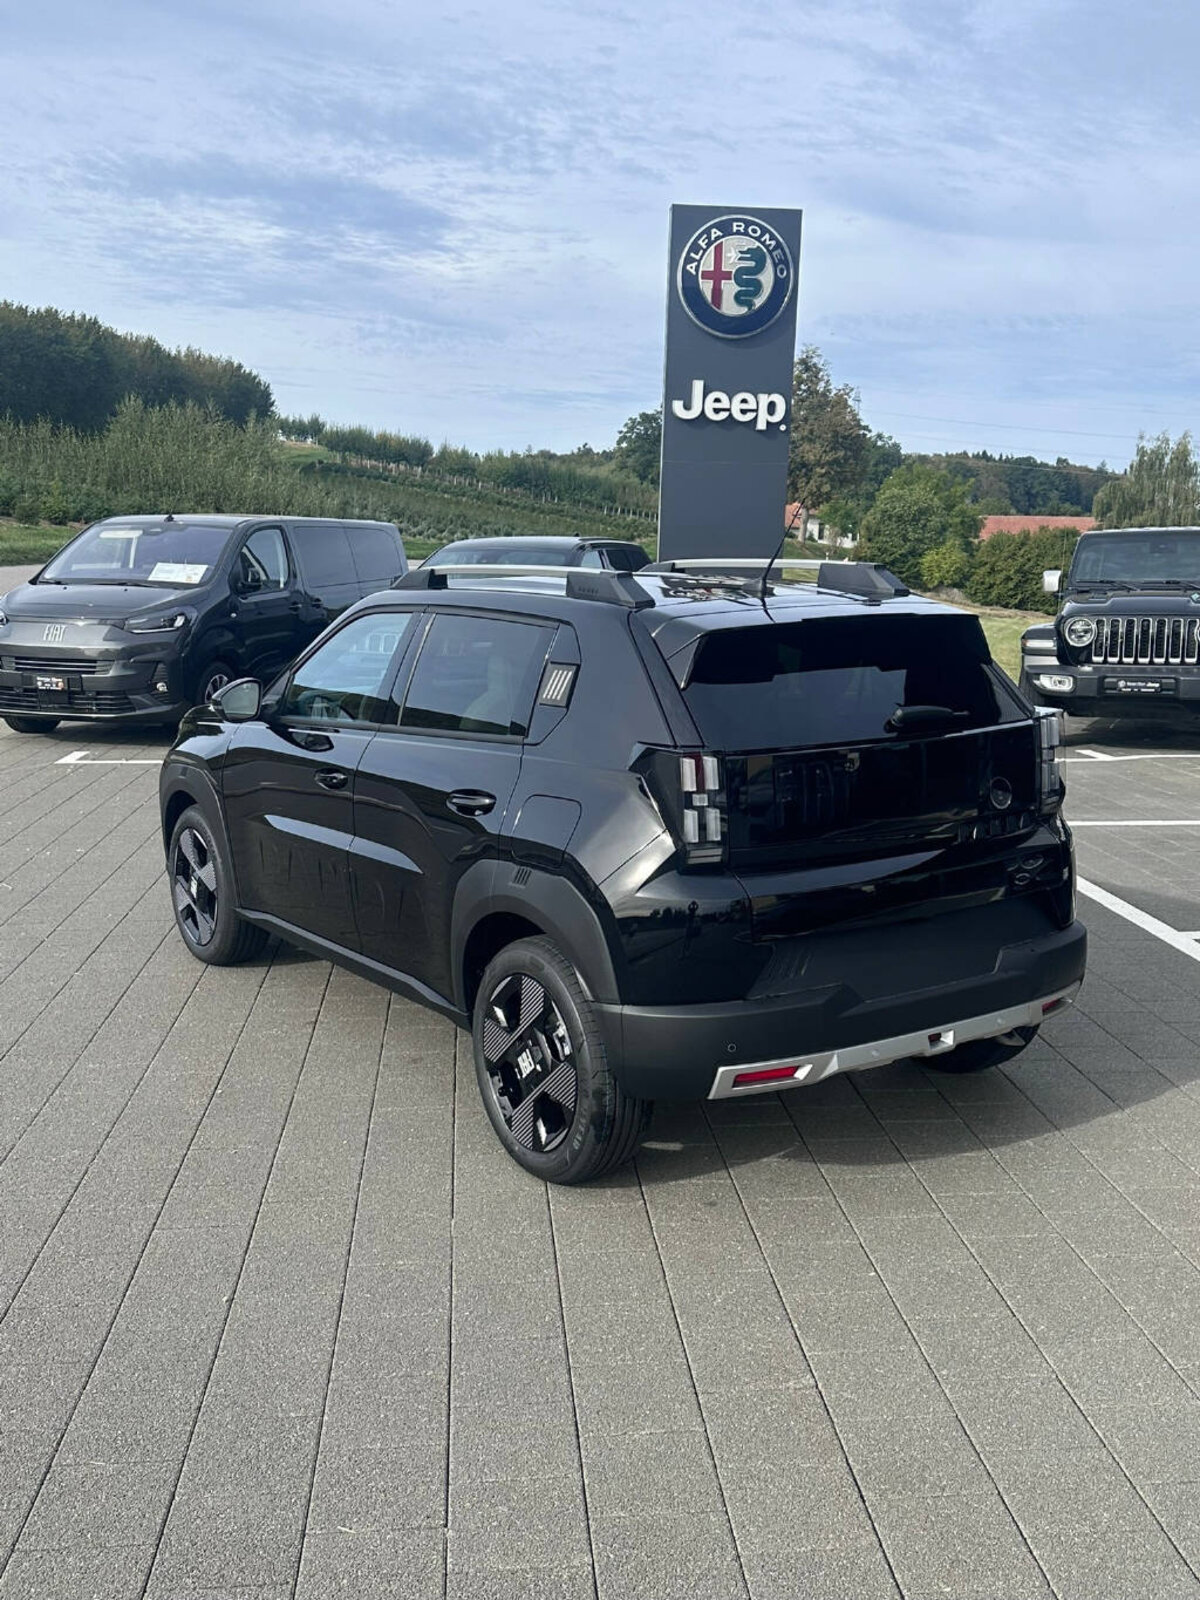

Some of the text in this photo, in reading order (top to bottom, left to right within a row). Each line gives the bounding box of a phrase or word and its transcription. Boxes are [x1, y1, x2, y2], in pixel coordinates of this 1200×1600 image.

[686, 222, 787, 279] ALFA ROMEO
[672, 379, 786, 431] Jeep
[43, 624, 66, 641] FIAT
